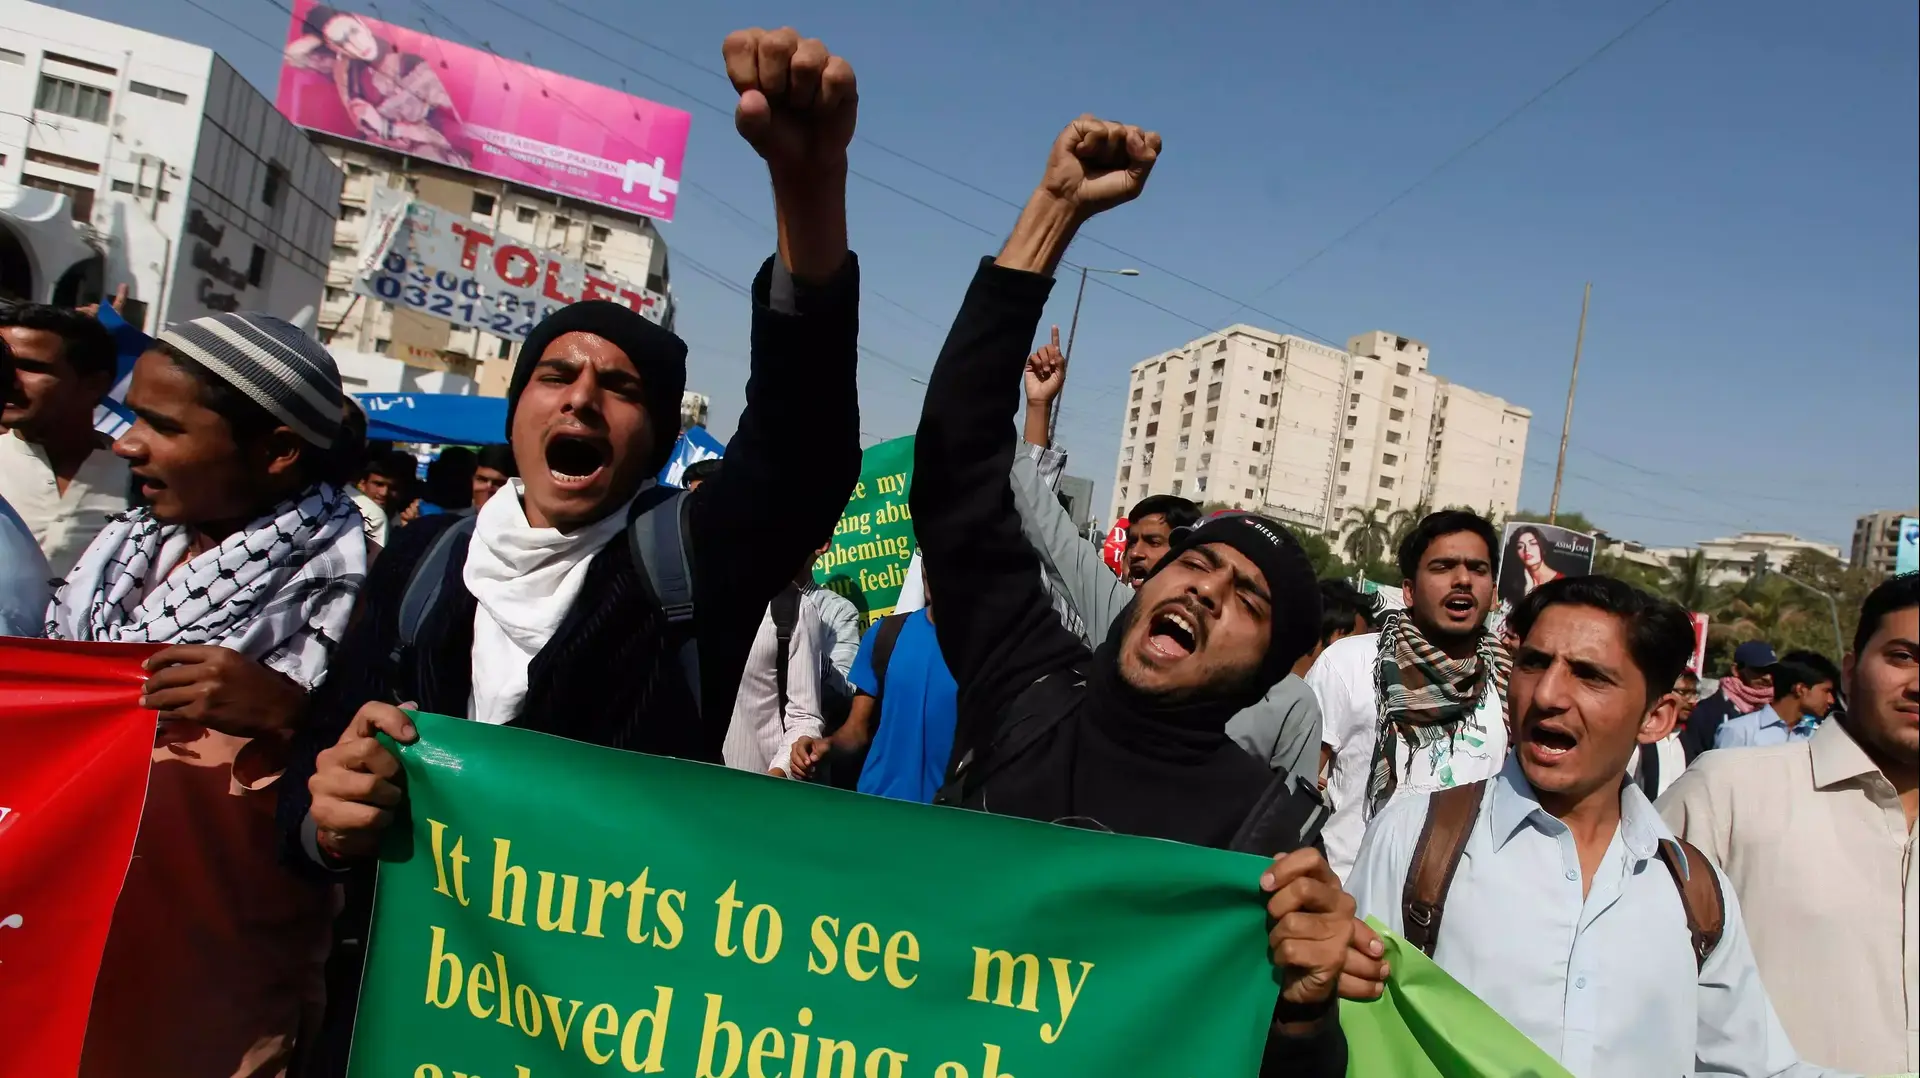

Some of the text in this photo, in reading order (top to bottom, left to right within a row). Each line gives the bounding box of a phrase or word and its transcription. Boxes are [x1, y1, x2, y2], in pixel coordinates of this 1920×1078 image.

[566, 152, 619, 173] PAKISTAN
[876, 472, 906, 495] my
[834, 501, 911, 535] eing abu
[1254, 523, 1281, 546] DIESEL
[811, 534, 910, 575] spheming
[427, 818, 1094, 1044] It hurts to see my
[425, 925, 674, 1075] beloved
